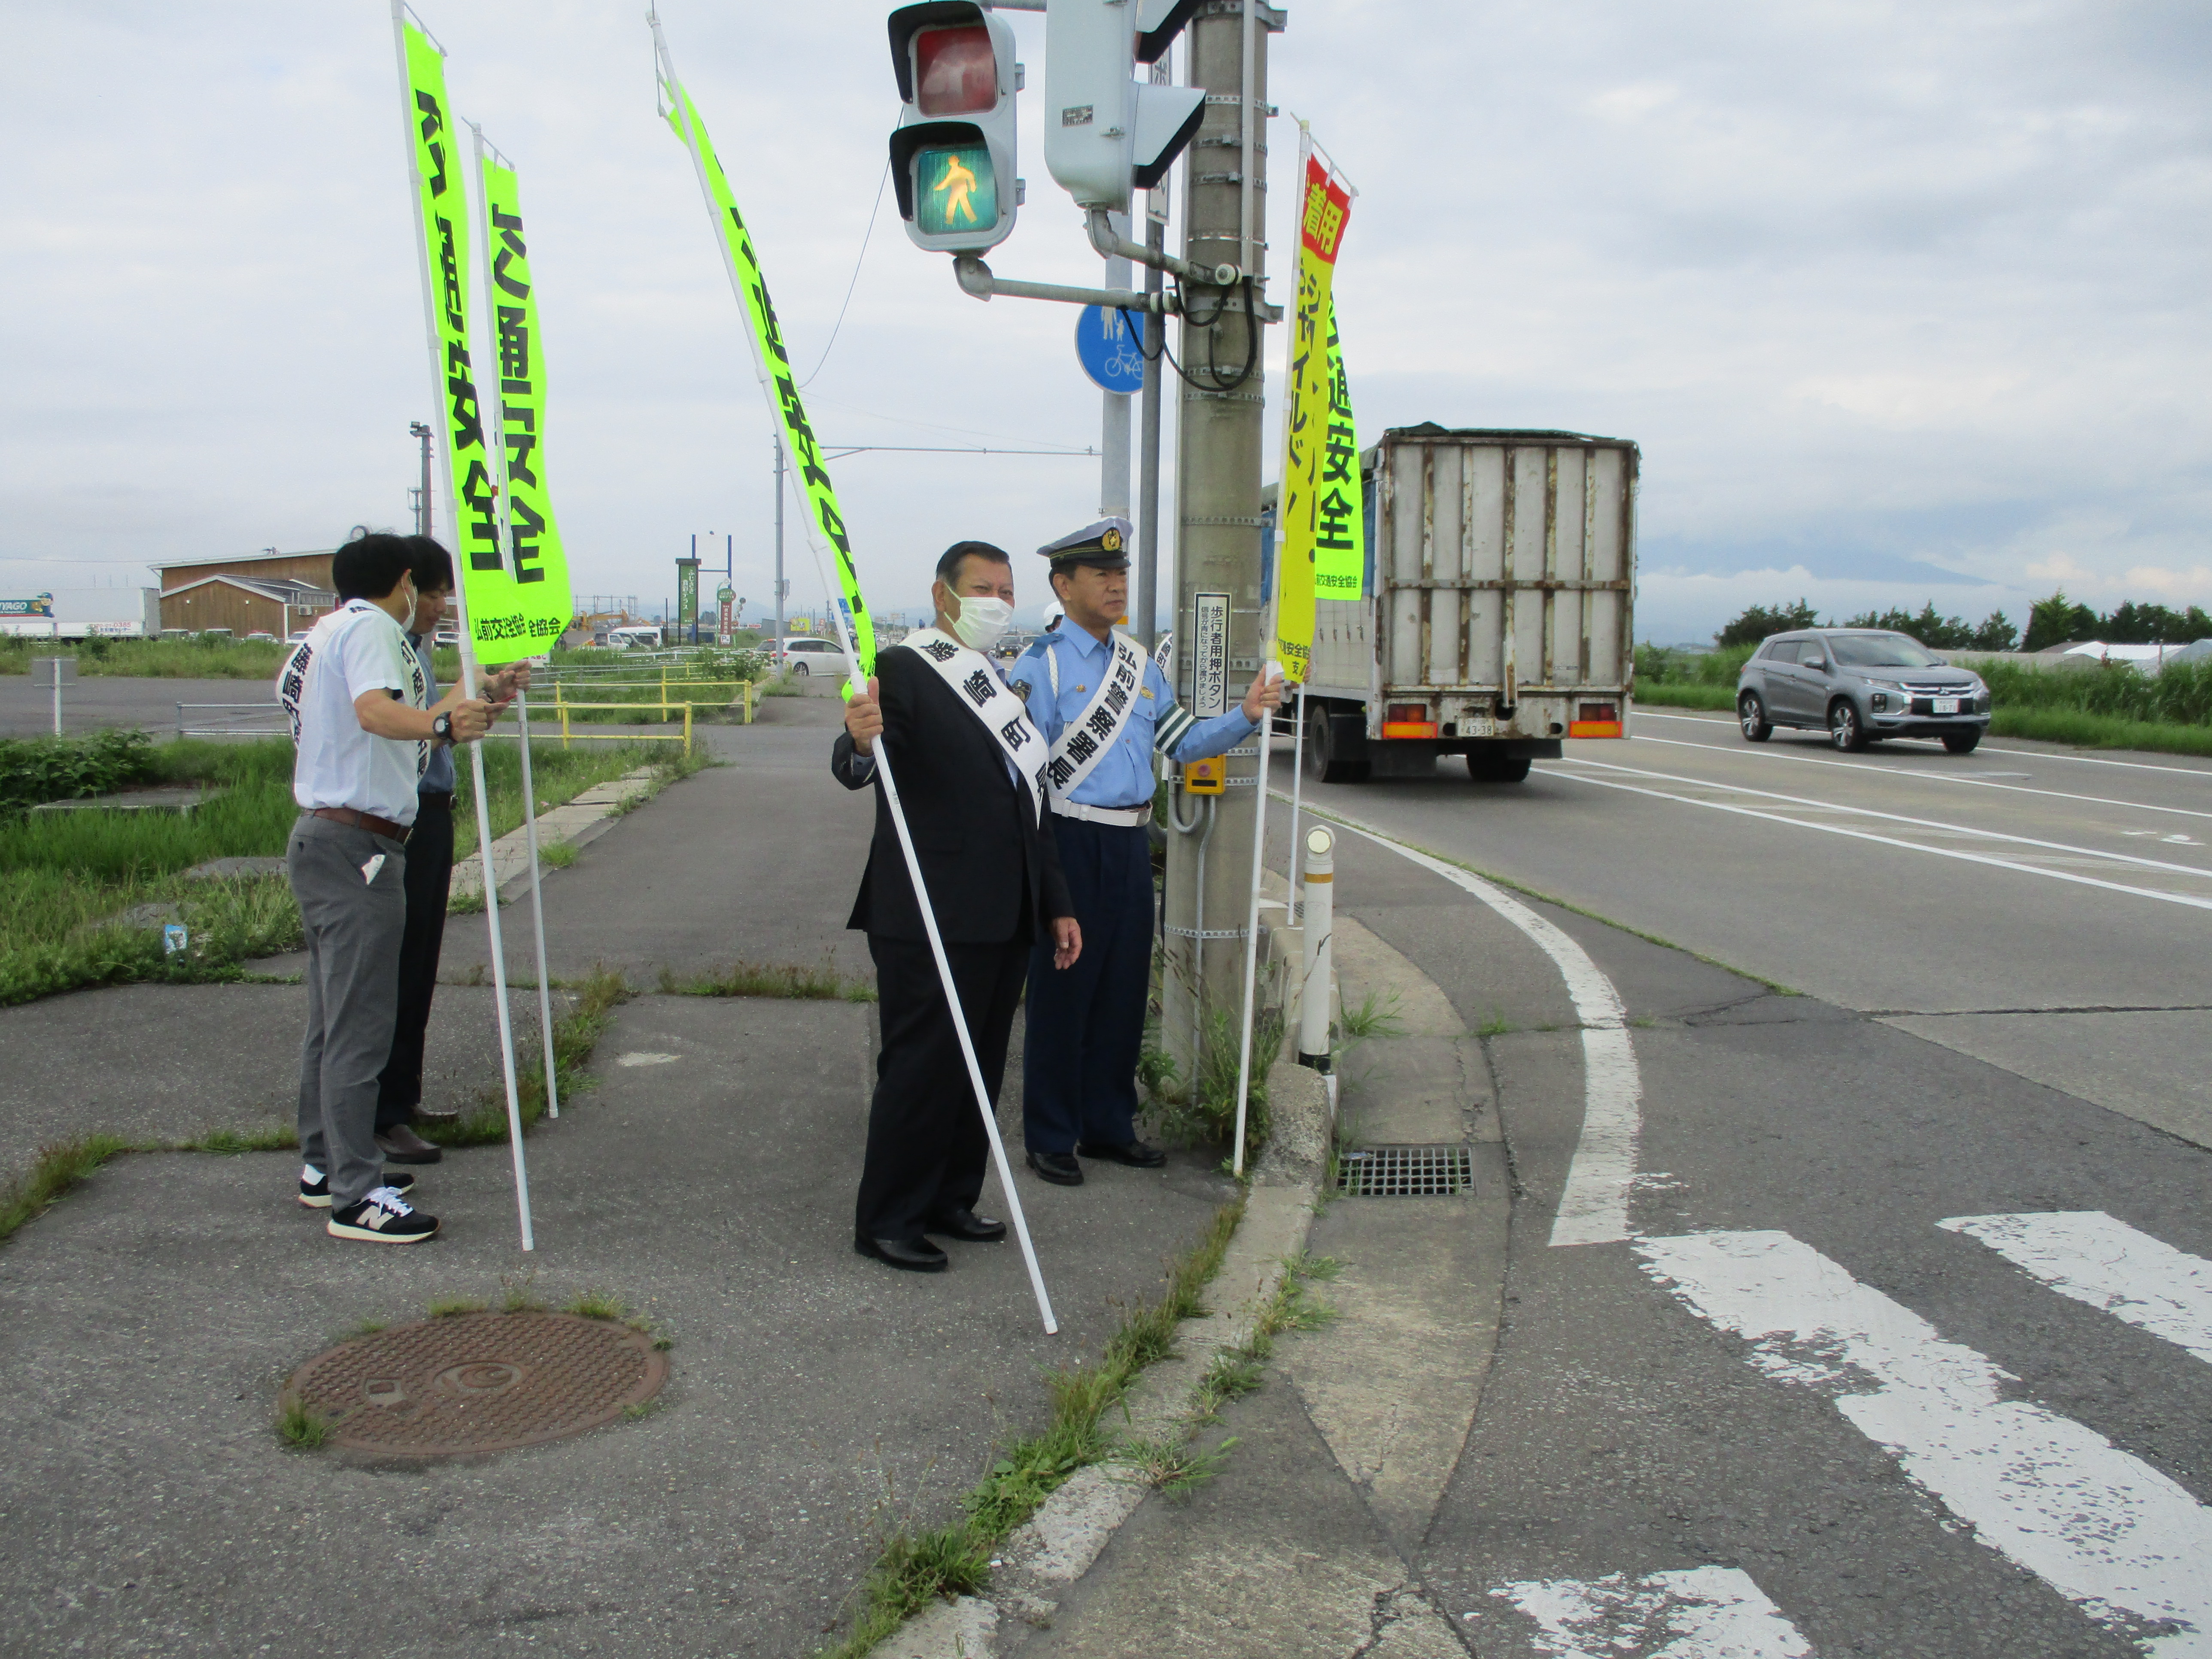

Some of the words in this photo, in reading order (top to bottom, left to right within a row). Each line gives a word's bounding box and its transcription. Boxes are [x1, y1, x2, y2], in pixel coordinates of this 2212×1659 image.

[1316, 574, 1357, 588] 前交通安全協会
[1209, 606, 1223, 708] 歩行者用押ボタン
[1048, 641, 1137, 790] 弘前警察署長
